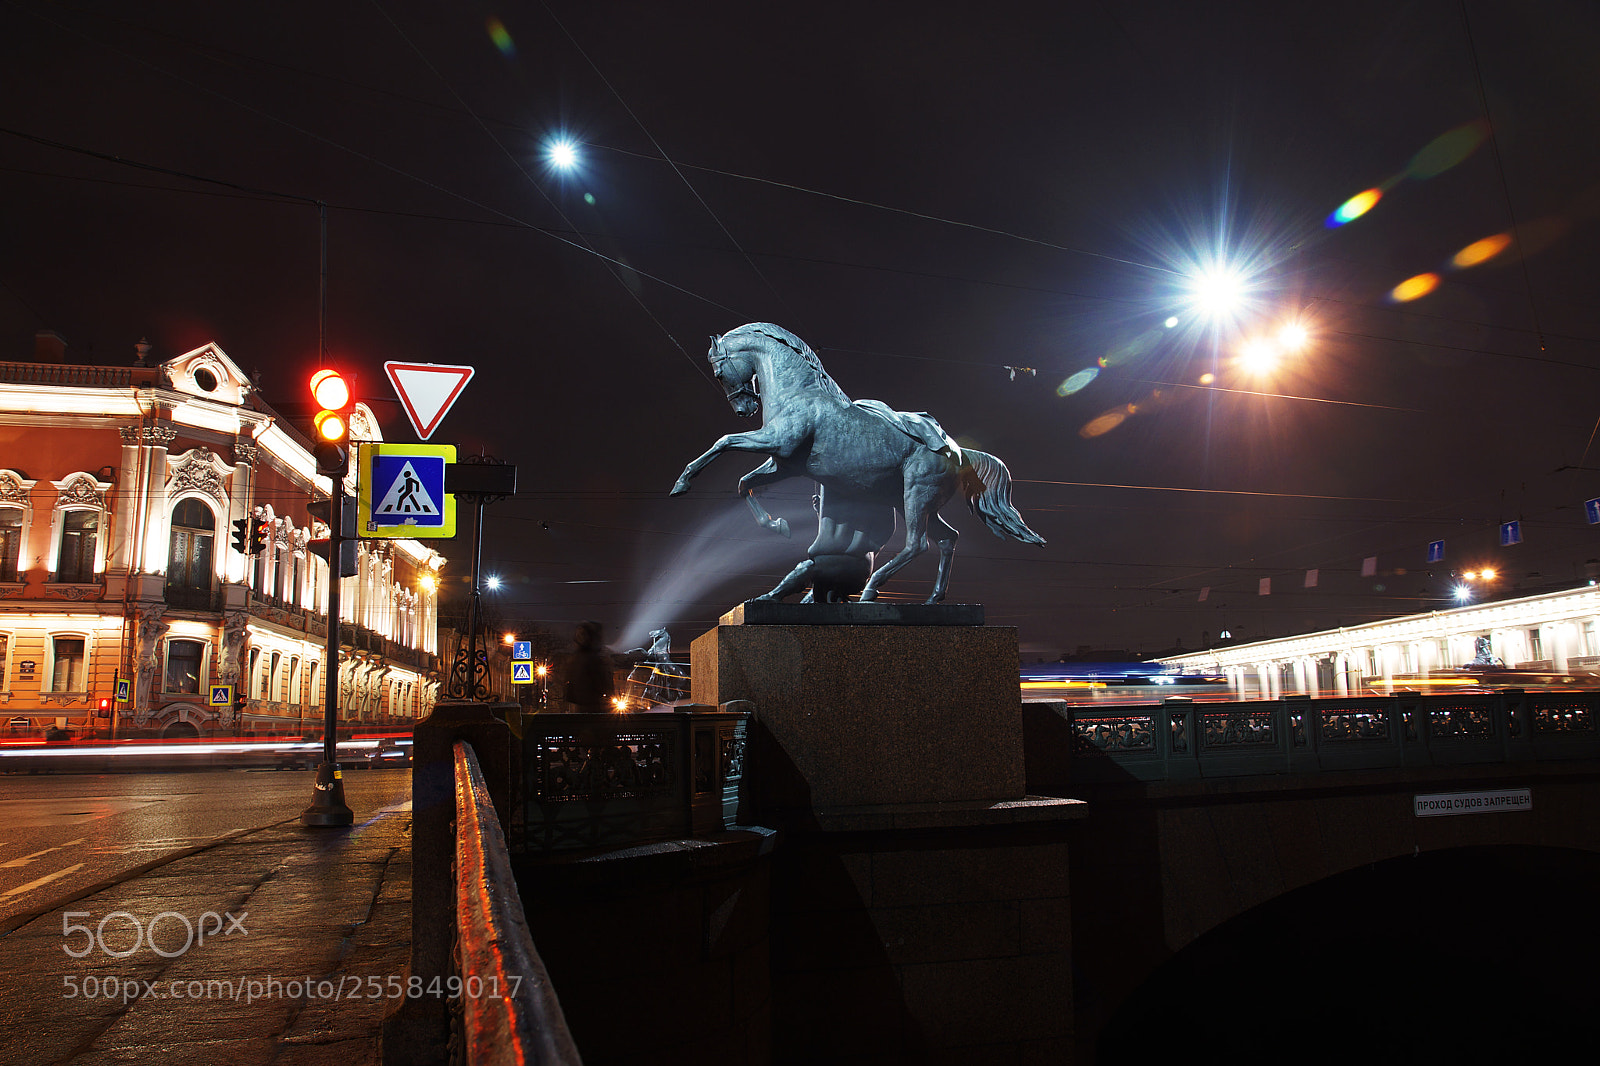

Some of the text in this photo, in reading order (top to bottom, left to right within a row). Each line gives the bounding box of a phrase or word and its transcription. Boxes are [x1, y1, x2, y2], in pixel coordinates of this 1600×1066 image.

[1417, 795, 1530, 810] ПРОХОД СУДОВ ЗАПРЕЩЕН
